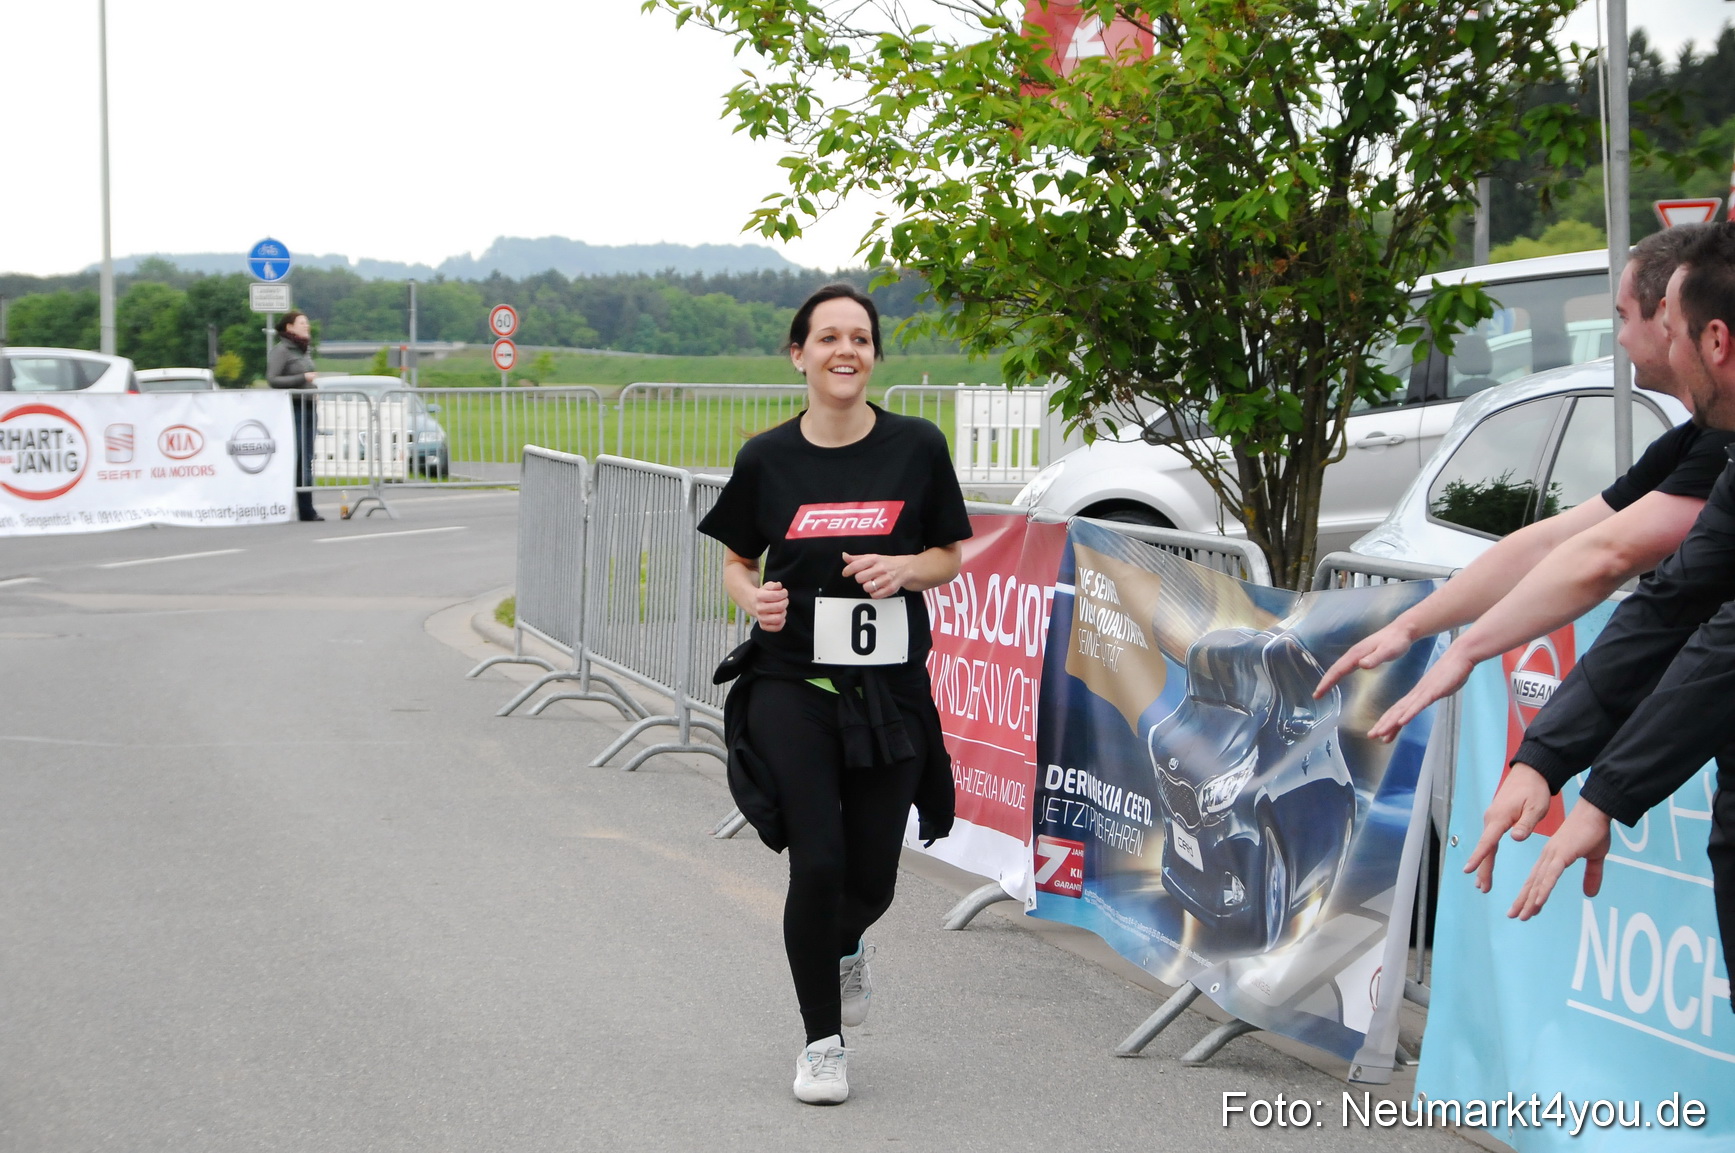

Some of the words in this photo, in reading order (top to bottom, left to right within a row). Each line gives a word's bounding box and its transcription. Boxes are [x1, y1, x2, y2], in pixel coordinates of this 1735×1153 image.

[496, 313, 511, 328] 60
[165, 433, 196, 452] KIA
[231, 442, 272, 453] NISSAN
[12, 451, 78, 474] JÄNIG
[150, 467, 167, 478] KIA
[169, 464, 215, 478] MOTORS
[97, 469, 142, 481] SEAT
[797, 508, 889, 532] Franek
[850, 602, 877, 656] 6
[1045, 764, 1088, 795] DER
[1101, 783, 1123, 814] KIA
[1039, 796, 1089, 829] JETZT
[1034, 836, 1072, 885] 7
